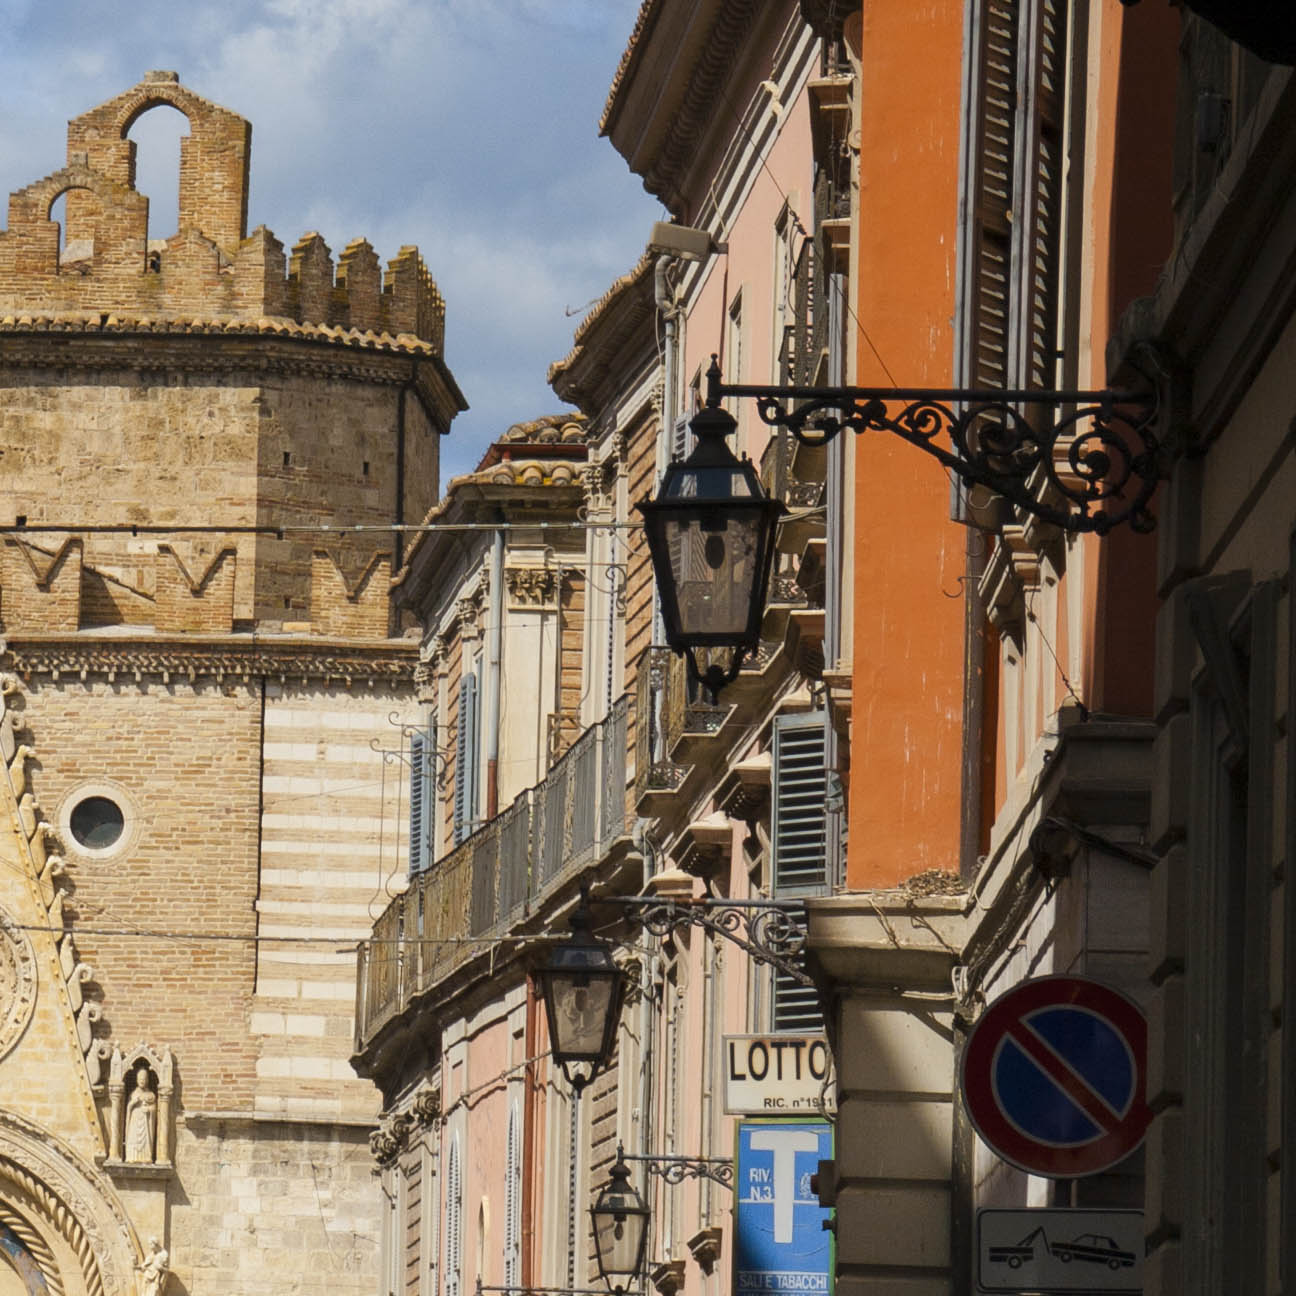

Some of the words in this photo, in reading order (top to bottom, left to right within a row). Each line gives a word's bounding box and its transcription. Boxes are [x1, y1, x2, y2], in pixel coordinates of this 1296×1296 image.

[730, 1040, 826, 1081] LOTTO
[764, 1097, 788, 1108] RIC.
[750, 1168, 772, 1183] RIV.
[738, 1274, 763, 1288] SALI
[765, 1274, 773, 1288] E
[776, 1275, 827, 1289] TABACCHI
